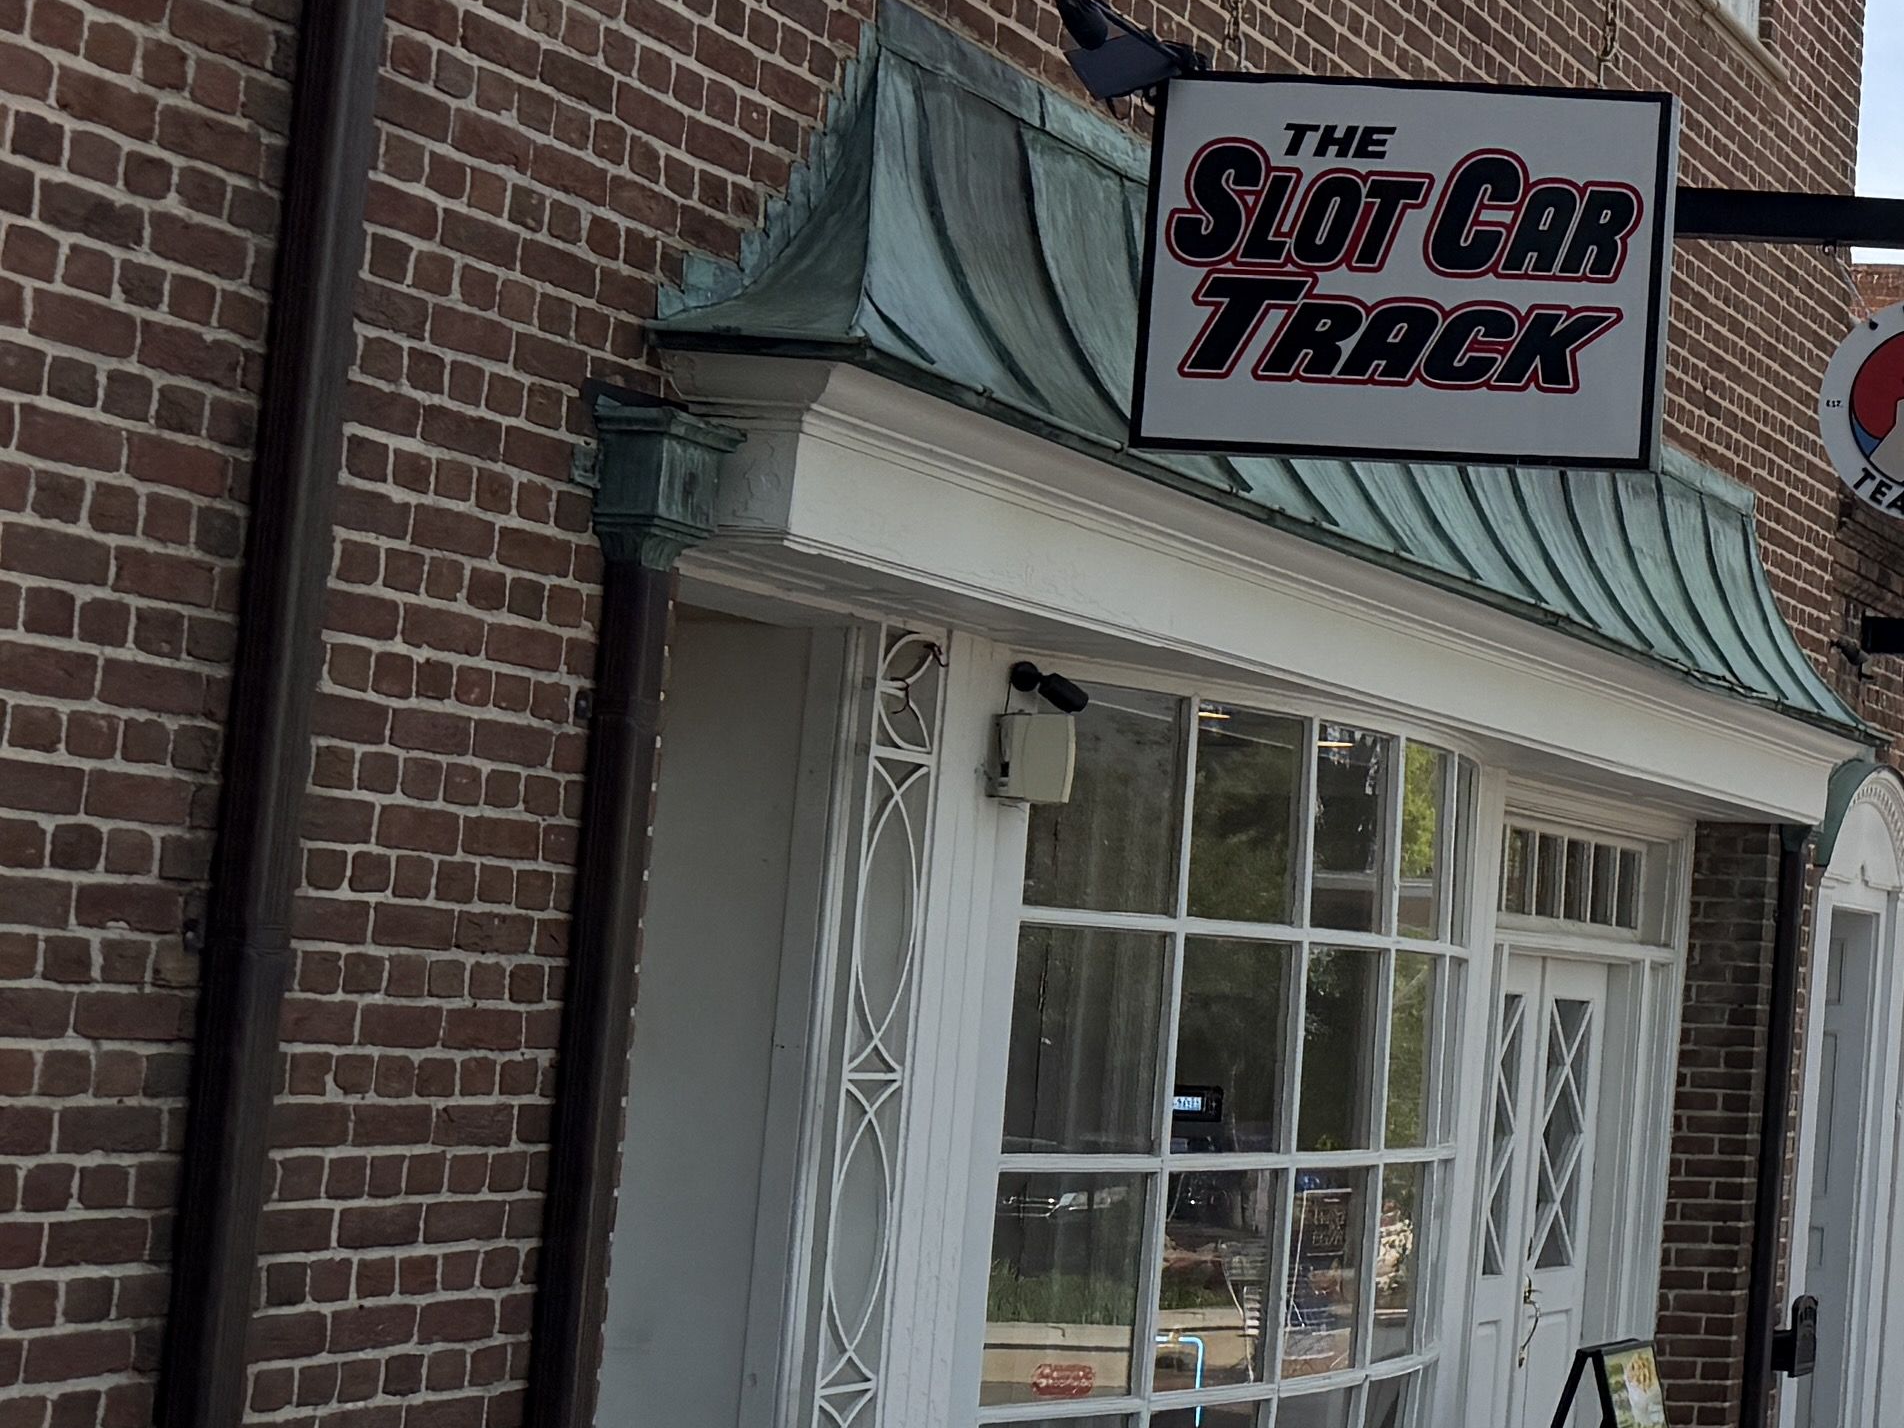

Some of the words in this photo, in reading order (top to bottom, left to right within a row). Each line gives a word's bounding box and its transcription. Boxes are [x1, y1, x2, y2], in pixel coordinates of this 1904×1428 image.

[1283, 123, 1397, 160] THE
[1166, 138, 1434, 272] SLOT
[1424, 149, 1643, 282] CAR
[1178, 269, 1623, 393] TRACK
